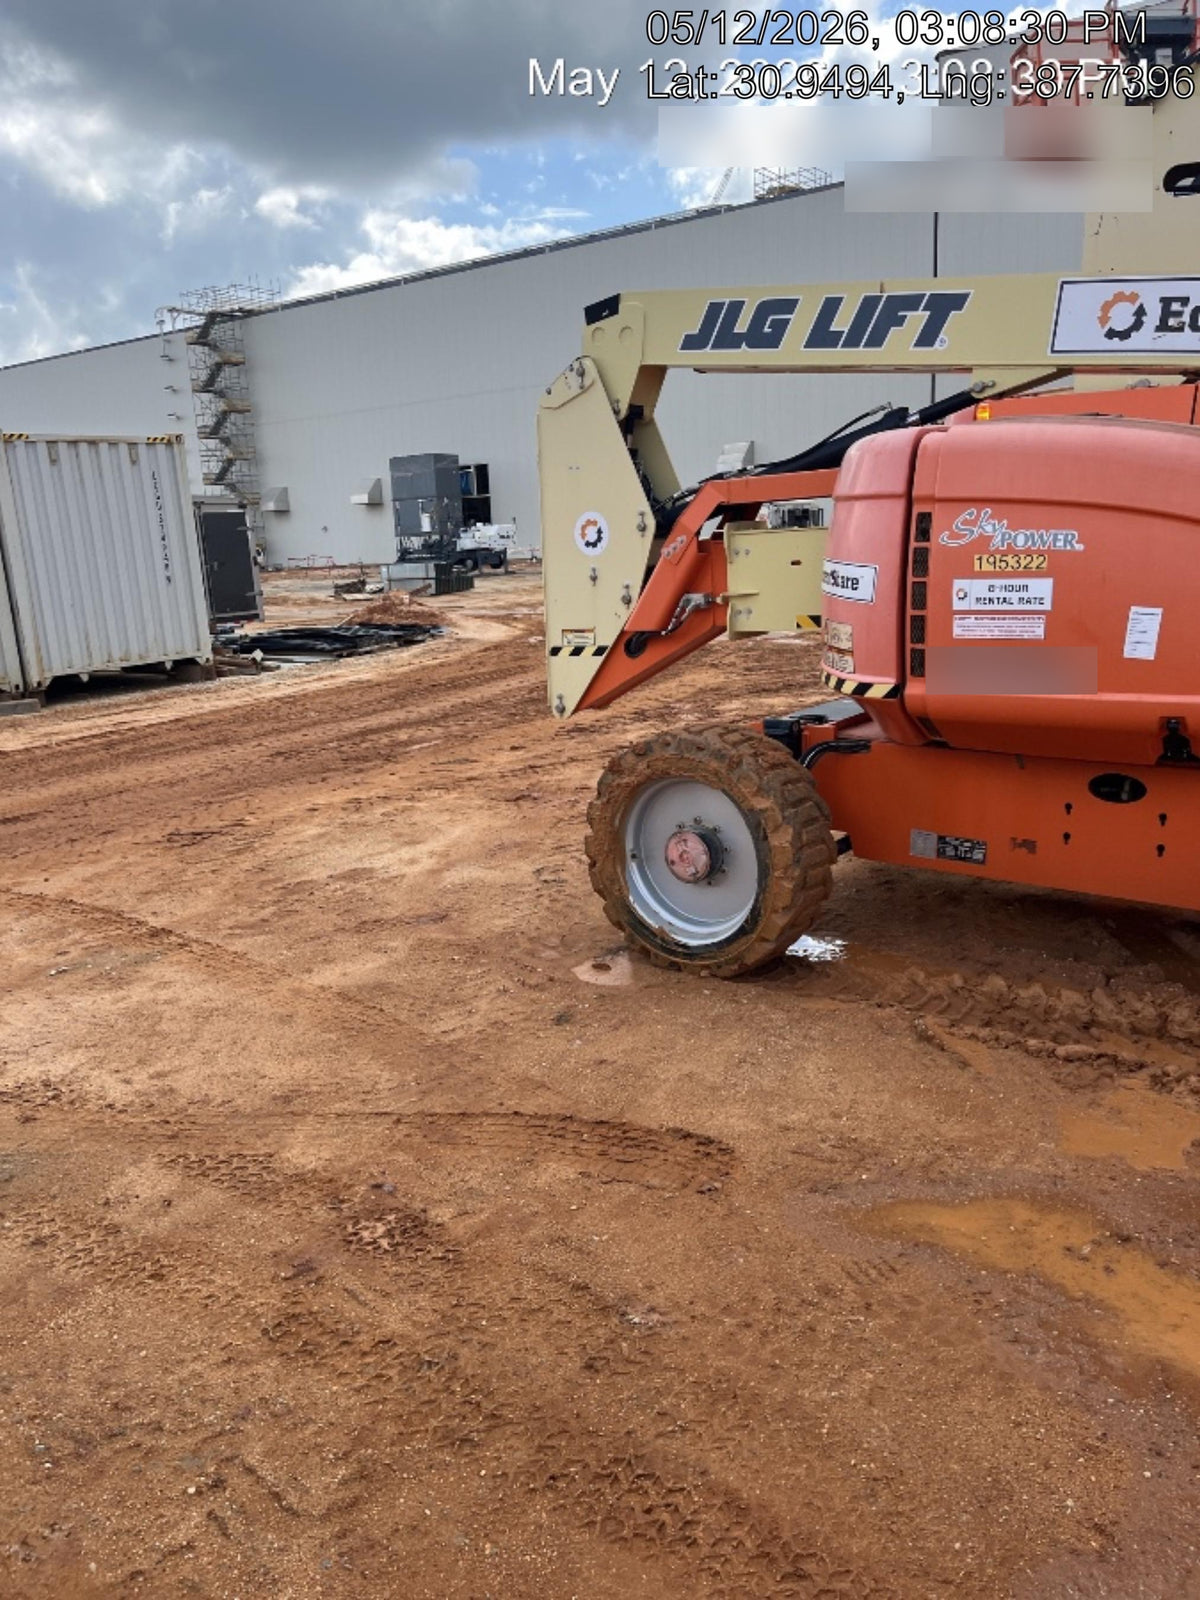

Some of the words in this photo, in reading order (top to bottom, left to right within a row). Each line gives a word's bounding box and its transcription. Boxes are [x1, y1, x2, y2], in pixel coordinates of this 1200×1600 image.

[679, 297, 801, 351] JLG
[802, 290, 974, 351] LIFT
[975, 554, 1047, 570] 195322
[975, 597, 1014, 606] RENTAL
[1018, 597, 1045, 606] RATE
